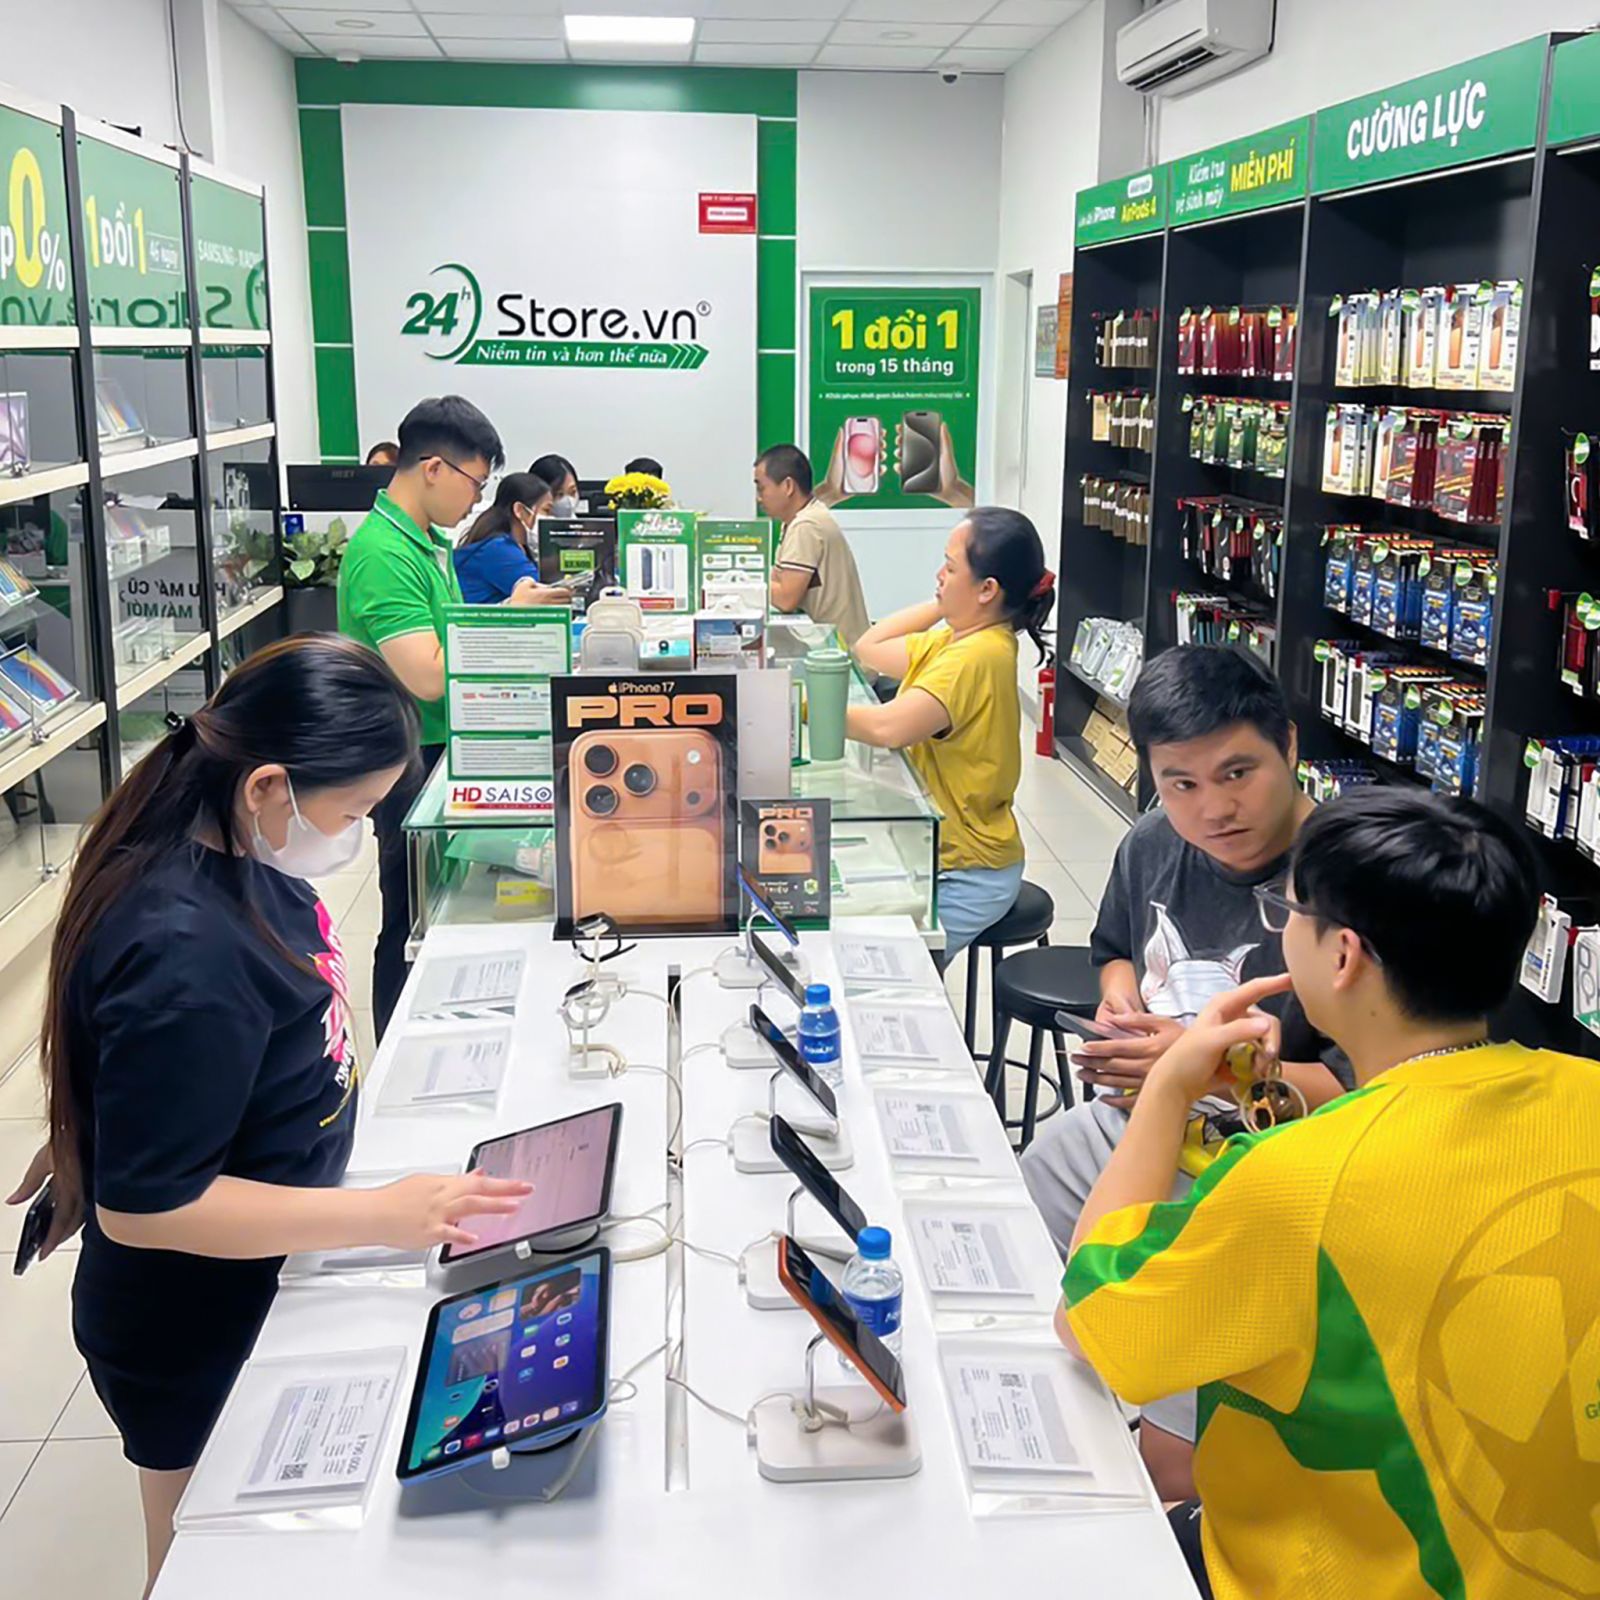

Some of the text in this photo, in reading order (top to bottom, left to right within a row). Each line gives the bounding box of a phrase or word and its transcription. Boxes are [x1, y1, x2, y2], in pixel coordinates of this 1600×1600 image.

[1347, 79, 1487, 160] CƯỜNG LỰC
[1231, 138, 1295, 192] MIỄN PHÍ
[86, 195, 146, 274] 1 ĐỔI 1
[832, 309, 958, 349] 1 đổi 1
[526, 345, 547, 361] tin
[552, 346, 570, 361] và
[575, 346, 604, 362] hơn
[609, 345, 638, 363] thế
[639, 349, 668, 364] nữa
[836, 357, 954, 376] trong 15 tháng
[618, 682, 675, 694] iPhone 17
[567, 693, 723, 728] PRO
[452, 787, 482, 802] HD
[759, 808, 813, 819] PRO
